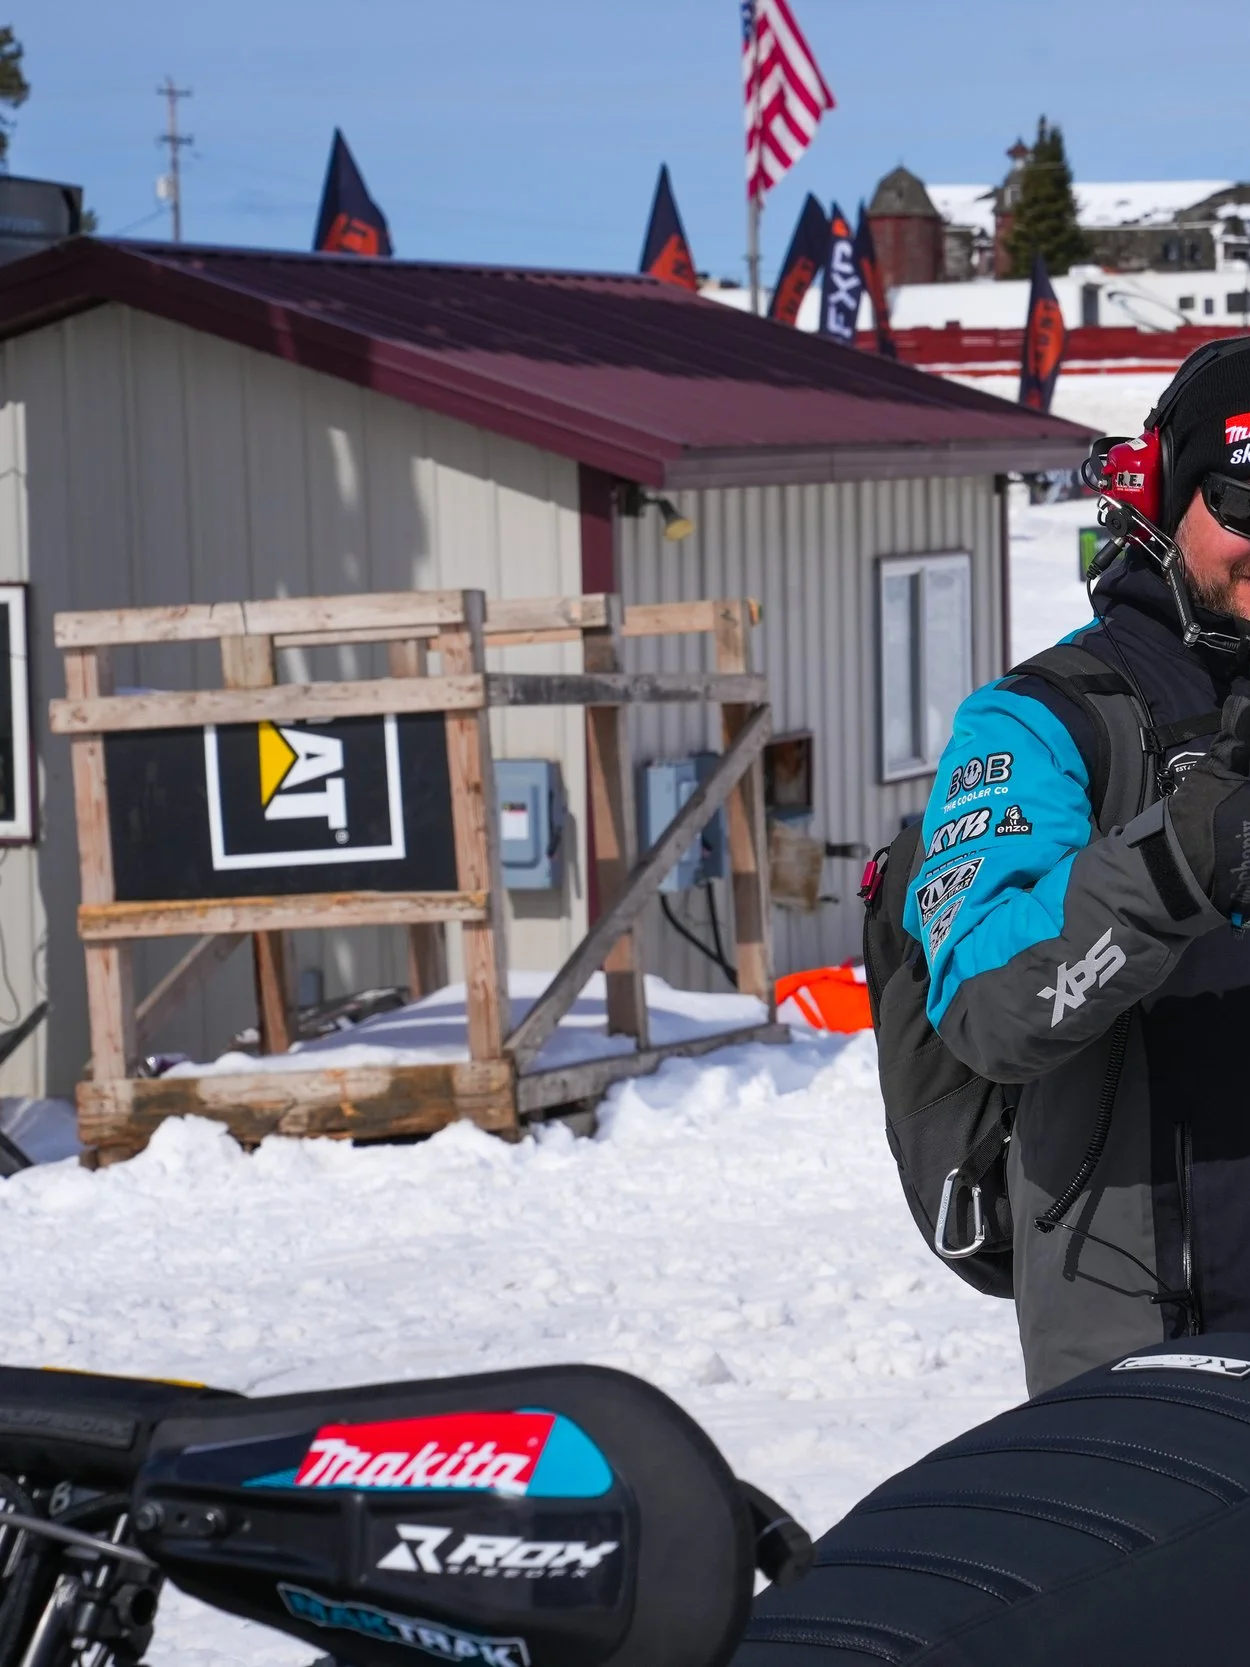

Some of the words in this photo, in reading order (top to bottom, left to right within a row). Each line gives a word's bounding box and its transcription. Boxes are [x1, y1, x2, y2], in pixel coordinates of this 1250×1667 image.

[262, 716, 349, 830] AT
[943, 799, 957, 814] THE
[956, 788, 991, 808] COOLER
[993, 786, 1009, 795] CO
[926, 808, 991, 858] KYB
[996, 823, 1029, 835] enzo
